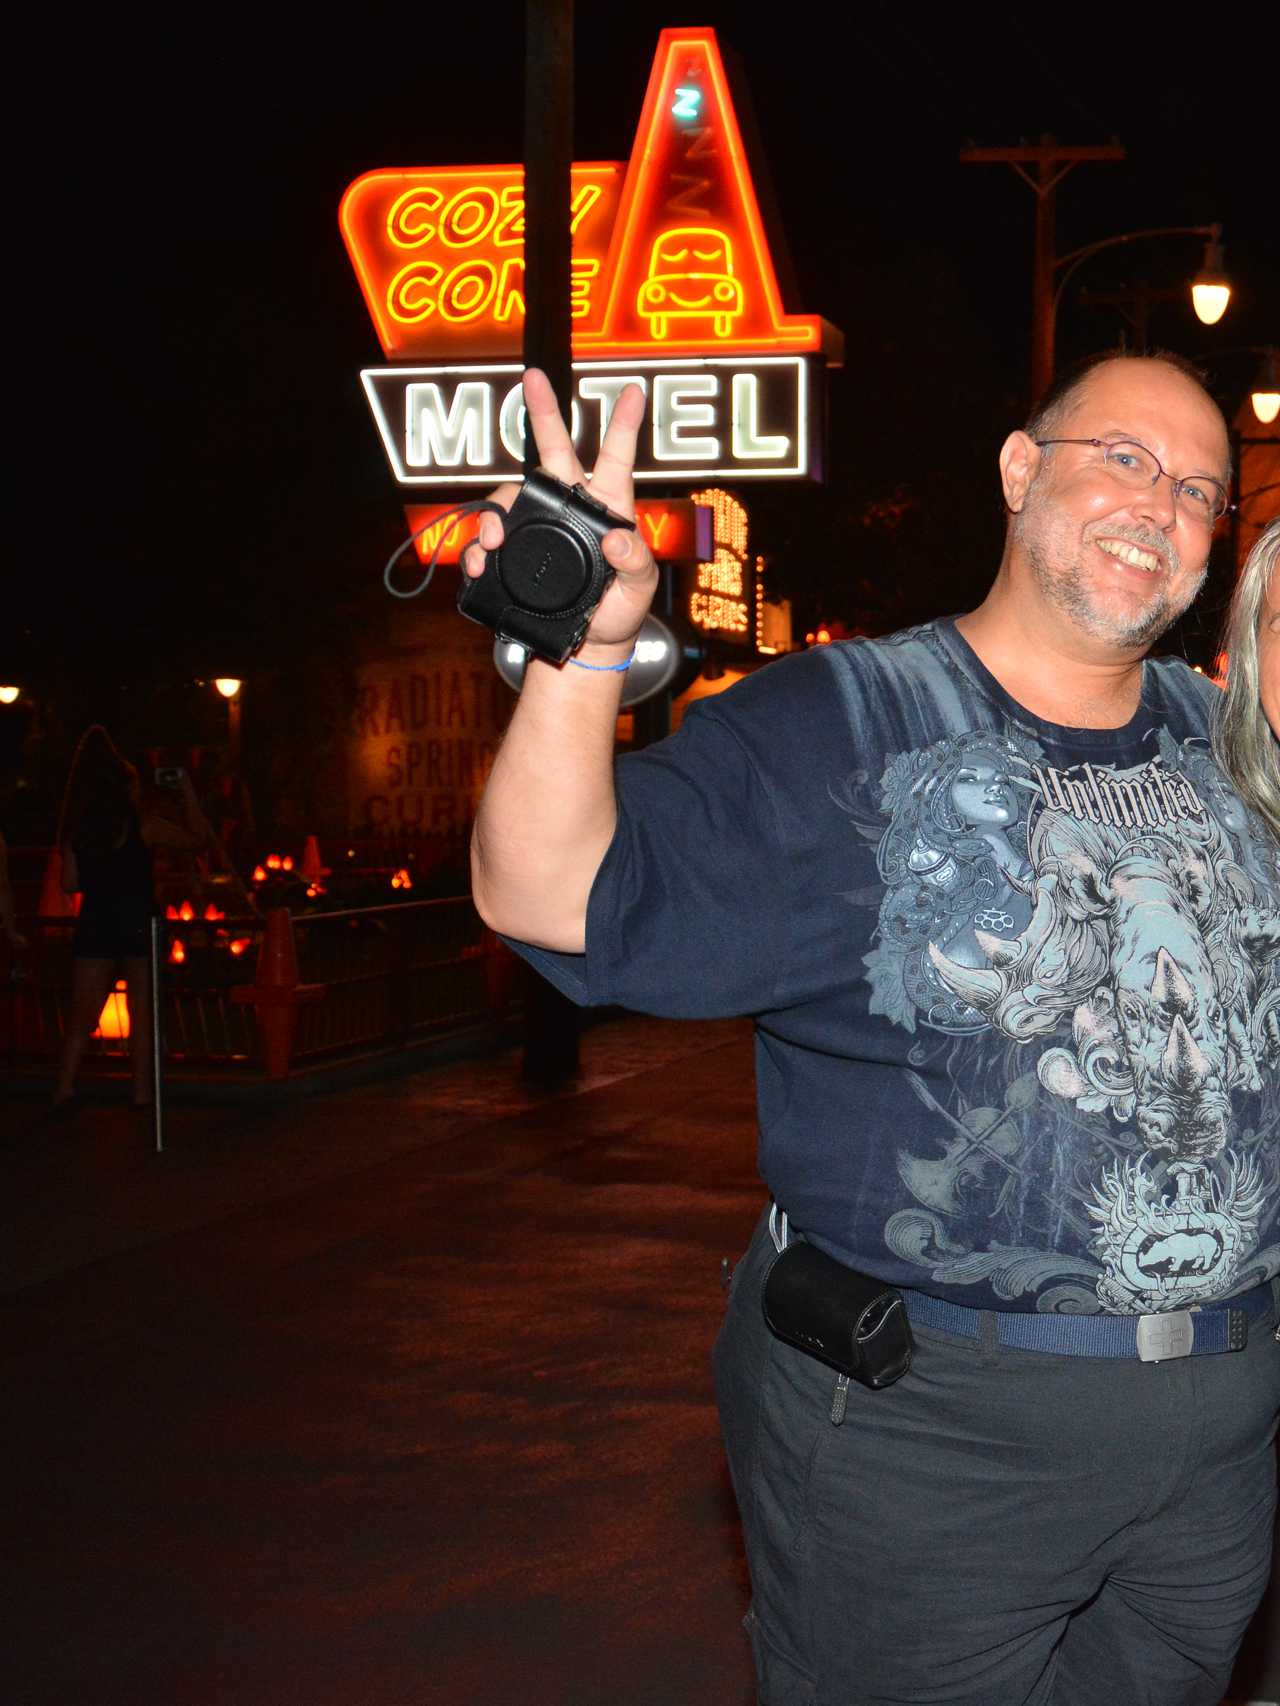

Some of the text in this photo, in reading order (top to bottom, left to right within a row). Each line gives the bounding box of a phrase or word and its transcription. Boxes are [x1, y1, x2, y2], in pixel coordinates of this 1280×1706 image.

[387, 258, 600, 323] CONE
[350, 671, 513, 736] RADIATO
[387, 739, 495, 788] SPRIN
[1030, 762, 1205, 828] Unlimited
[366, 794, 472, 826] CURI
